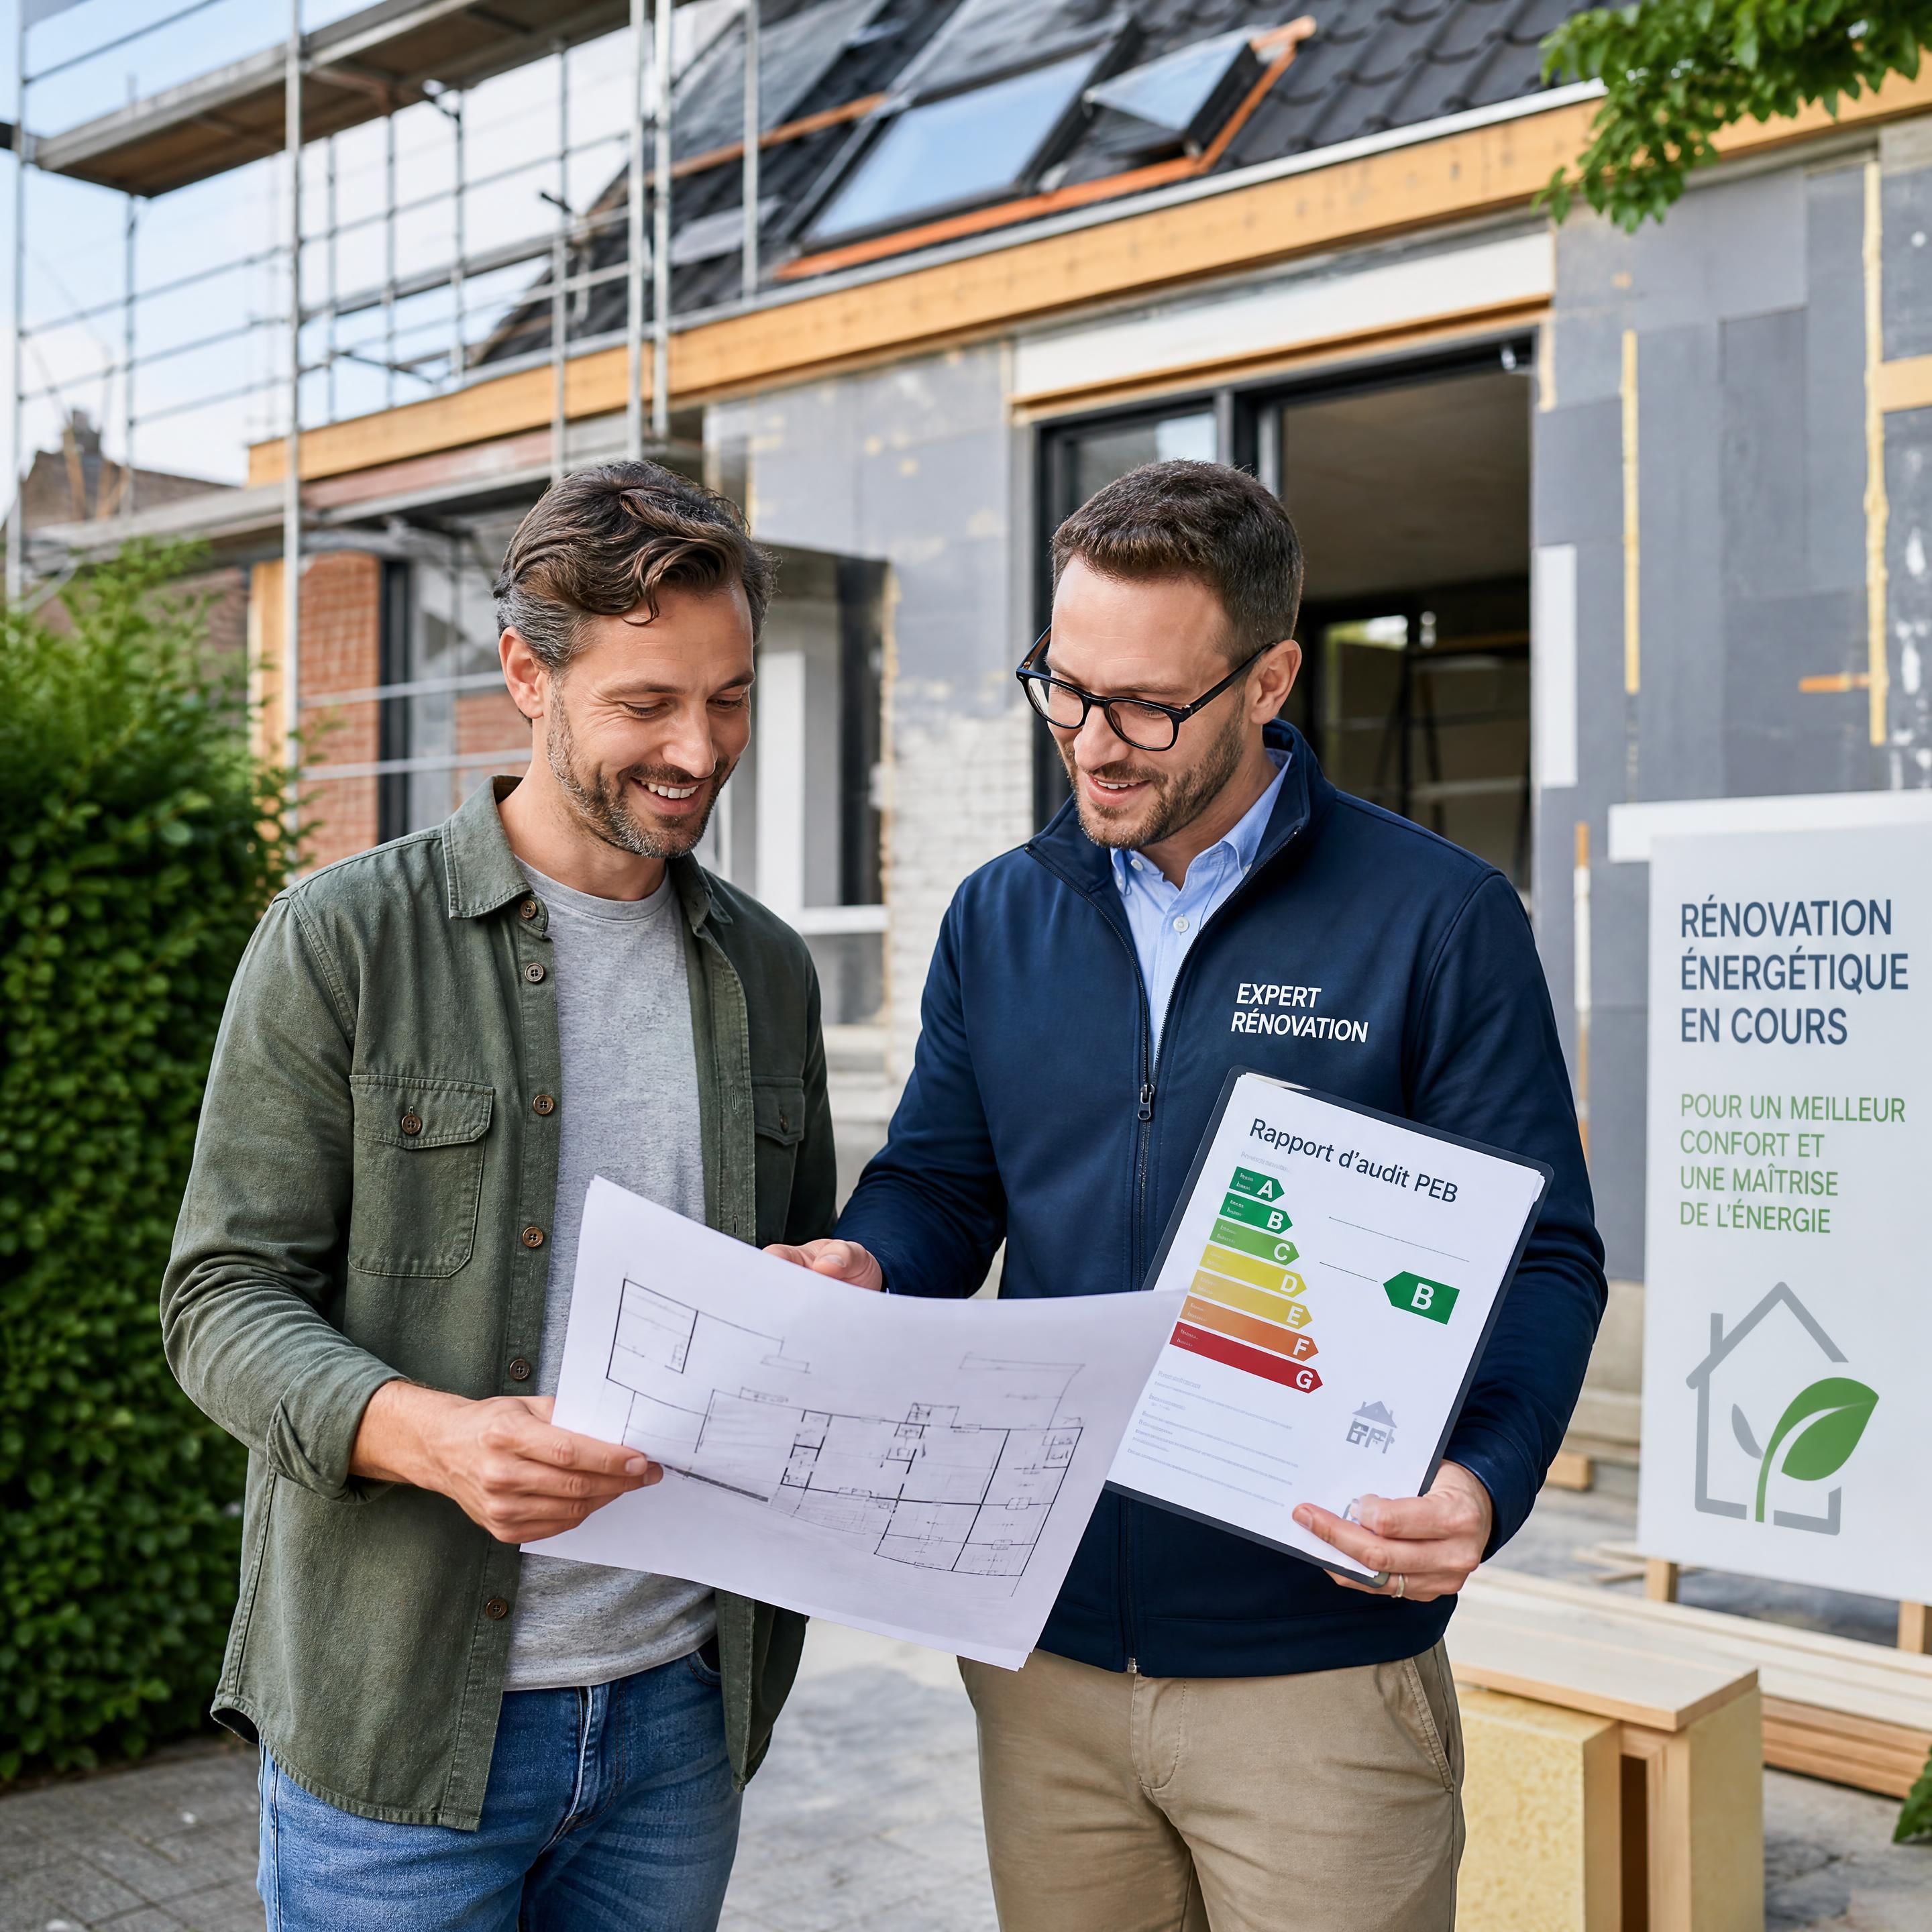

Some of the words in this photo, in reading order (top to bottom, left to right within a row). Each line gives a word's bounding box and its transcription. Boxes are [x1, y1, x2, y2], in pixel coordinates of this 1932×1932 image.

[1680, 894, 1892, 938] RÉNOVATION
[1680, 946, 1909, 995] ÉNERGÉTIQUE
[1236, 983, 1322, 1008] EXPERT
[1230, 1008, 1368, 1042] RÉNOVATION
[1680, 1007, 1720, 1043] EN
[1731, 1007, 1847, 1045] COURS
[1680, 1093, 1742, 1118] POUR
[1750, 1095, 1782, 1120] UN
[1790, 1095, 1905, 1122] MEILLEUR
[1680, 1130, 1790, 1157] CONFORT
[1798, 1133, 1825, 1159] ET
[1249, 1118, 1334, 1162] Rapport
[1338, 1150, 1410, 1188] d’audit
[1414, 1173, 1458, 1203] PEB
[1256, 1180, 1273, 1198] A
[1680, 1165, 1725, 1191] UNE
[1732, 1163, 1838, 1196] MAÎTRISE
[1267, 1211, 1284, 1230] B
[1680, 1201, 1709, 1228] DE
[1716, 1199, 1831, 1233] L’ÉNERGIE
[1274, 1243, 1291, 1261] C
[1280, 1274, 1297, 1293] D
[1410, 1282, 1434, 1310] B
[1286, 1305, 1303, 1326] E
[1293, 1337, 1309, 1356] F
[1295, 1370, 1313, 1389] G
